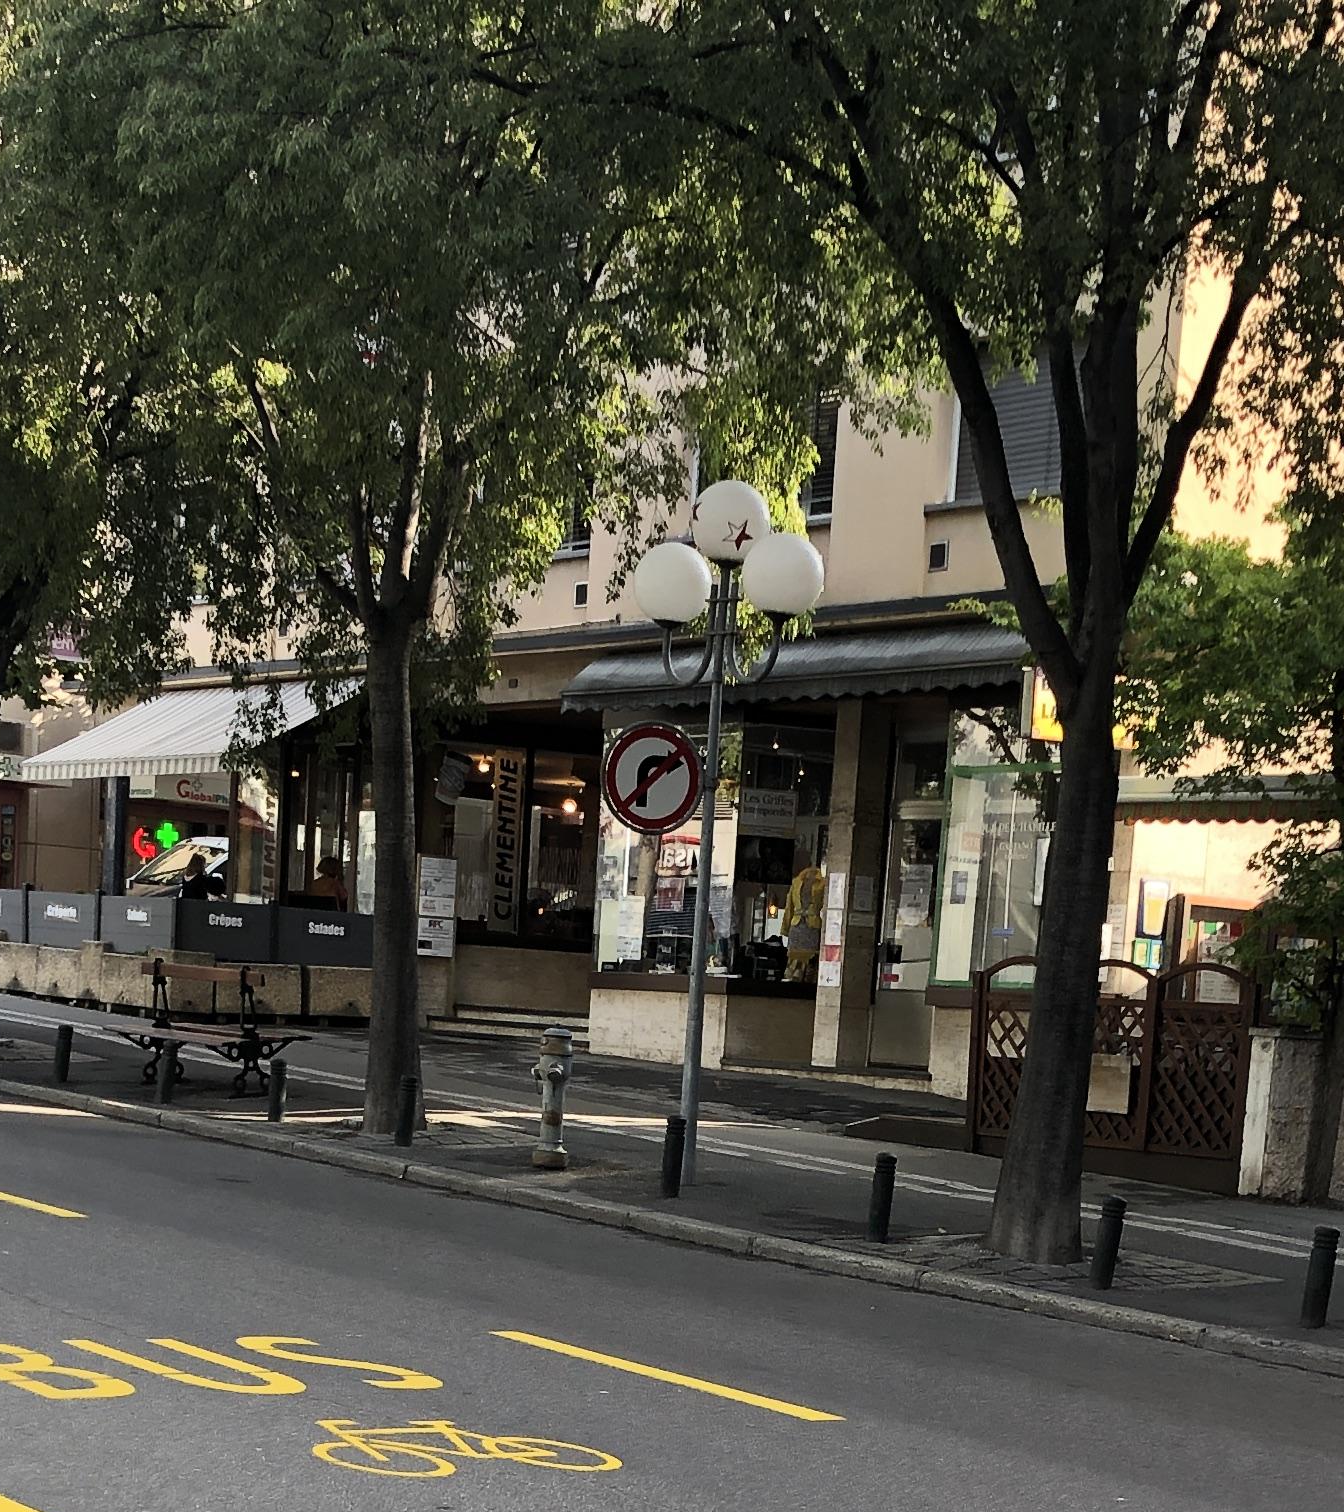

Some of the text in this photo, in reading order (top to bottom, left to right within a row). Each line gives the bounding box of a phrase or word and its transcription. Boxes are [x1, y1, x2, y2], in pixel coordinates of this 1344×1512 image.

[493, 757, 519, 921] CLEMENTINE
[208, 913, 243, 928] Crêpes
[308, 921, 345, 937] Salades
